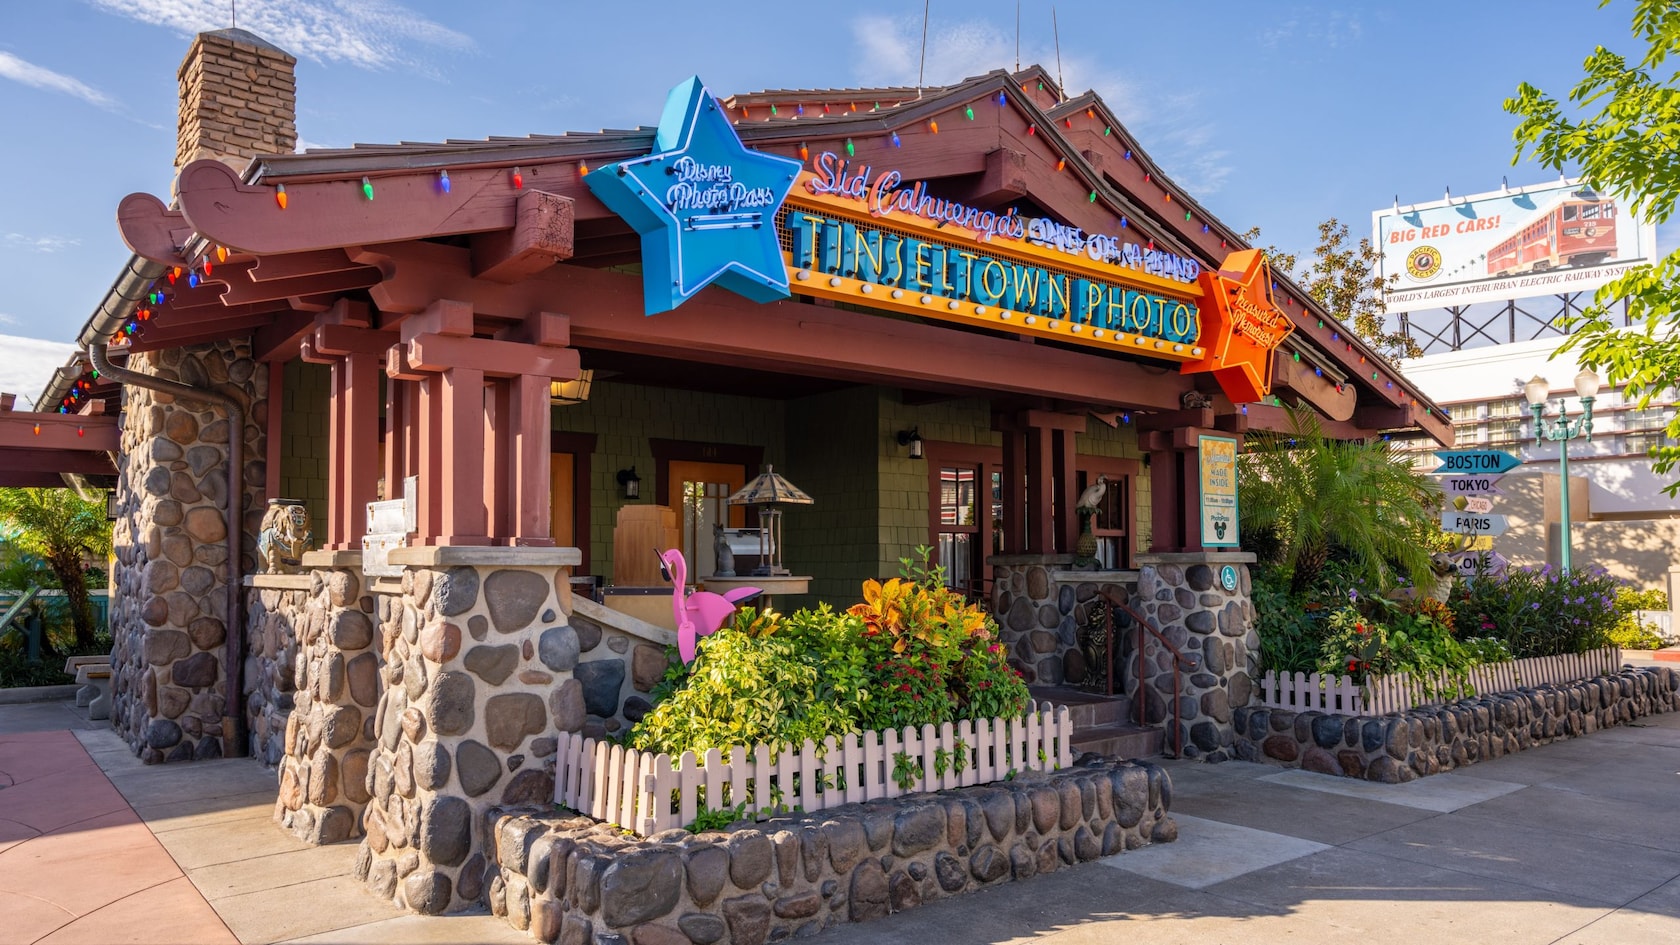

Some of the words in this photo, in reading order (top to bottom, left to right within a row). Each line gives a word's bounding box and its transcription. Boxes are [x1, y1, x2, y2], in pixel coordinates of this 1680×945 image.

[673, 155, 732, 184] Disney
[805, 151, 872, 201] Sid
[868, 170, 1025, 243] Cahuenga's
[1143, 248, 1200, 283] KIND
[1390, 228, 1416, 244] BIG
[1421, 223, 1451, 239] RED
[1456, 214, 1501, 234] CARS!
[1409, 247, 1438, 260] PACIFIC
[785, 211, 1070, 318] TINSELTOWN
[1408, 262, 1439, 278] ELECTRIC
[1386, 293, 1423, 304] WORLD'S
[1423, 287, 1461, 300] LARGEST
[1461, 280, 1518, 295] INTERURBAN
[1519, 274, 1562, 288] ELECTRIC
[1564, 268, 1603, 282] RAILWAY
[1604, 264, 1638, 277] SYST
[1235, 286, 1280, 329] Treasured
[1447, 454, 1500, 469] BOSTON
[1210, 467, 1228, 478] MADE
[1209, 478, 1230, 488] INSIDE
[1450, 479, 1490, 491] TOKYO
[1456, 517, 1490, 530] PARIS
[1458, 558, 1491, 569] OE
